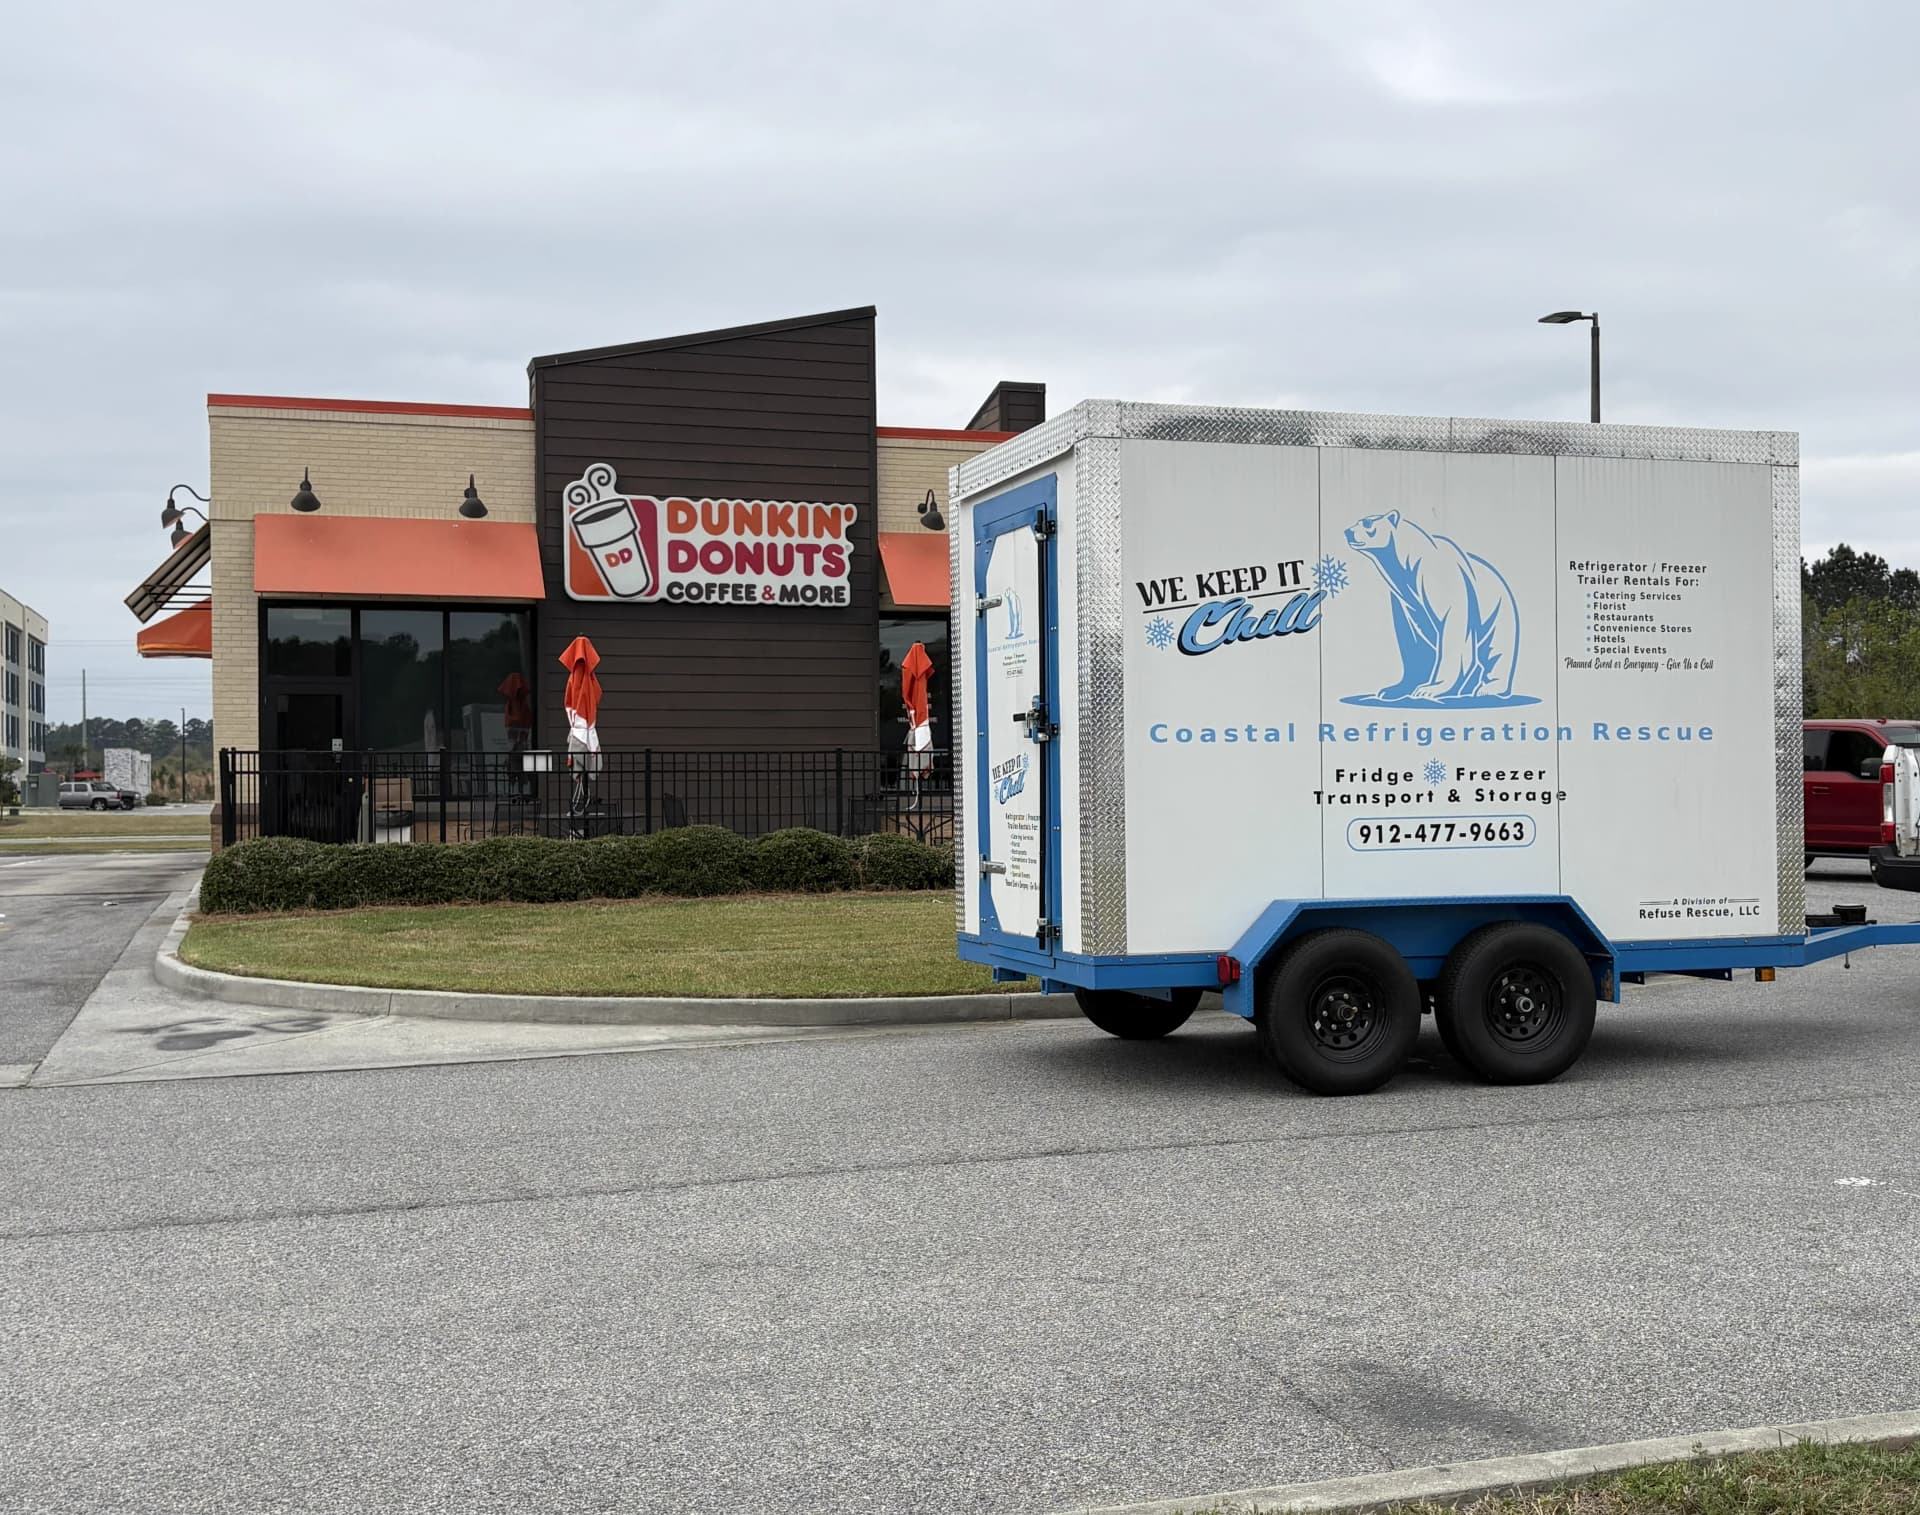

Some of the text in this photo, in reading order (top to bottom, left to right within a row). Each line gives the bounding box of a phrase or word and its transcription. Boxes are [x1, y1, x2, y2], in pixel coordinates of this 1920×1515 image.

[667, 500, 854, 539] DUNKIN'
[605, 548, 632, 567] DD
[667, 540, 846, 577] DONUTS
[1570, 561, 1647, 573] Refrigerator
[1661, 563, 1707, 573] Freezer
[1136, 560, 1304, 606] WE KEEP IT
[1577, 575, 1699, 586] Trailer Rentals For:
[667, 581, 846, 603] COFFEE & MORE
[1593, 591, 1682, 601] Catering Services
[1593, 602, 1627, 611] Florist
[1177, 590, 1327, 656] Chill
[1593, 613, 1654, 622] Restaurants
[1593, 624, 1692, 633] Convenience Stores
[1593, 635, 1626, 643] Hotels
[1593, 646, 1667, 655] Special Events
[1564, 657, 1592, 669] Planned
[1624, 657, 1659, 672] Emergency
[1150, 722, 1713, 746] Coastal Refrigeration Rescue
[1335, 767, 1547, 786] Fridge Freezer
[1313, 788, 1567, 807] Transport & Storage
[1359, 822, 1524, 844] 912-477-9663
[1719, 897, 1727, 905] of
[1639, 905, 1760, 919] Refuse Rescue, LLC
